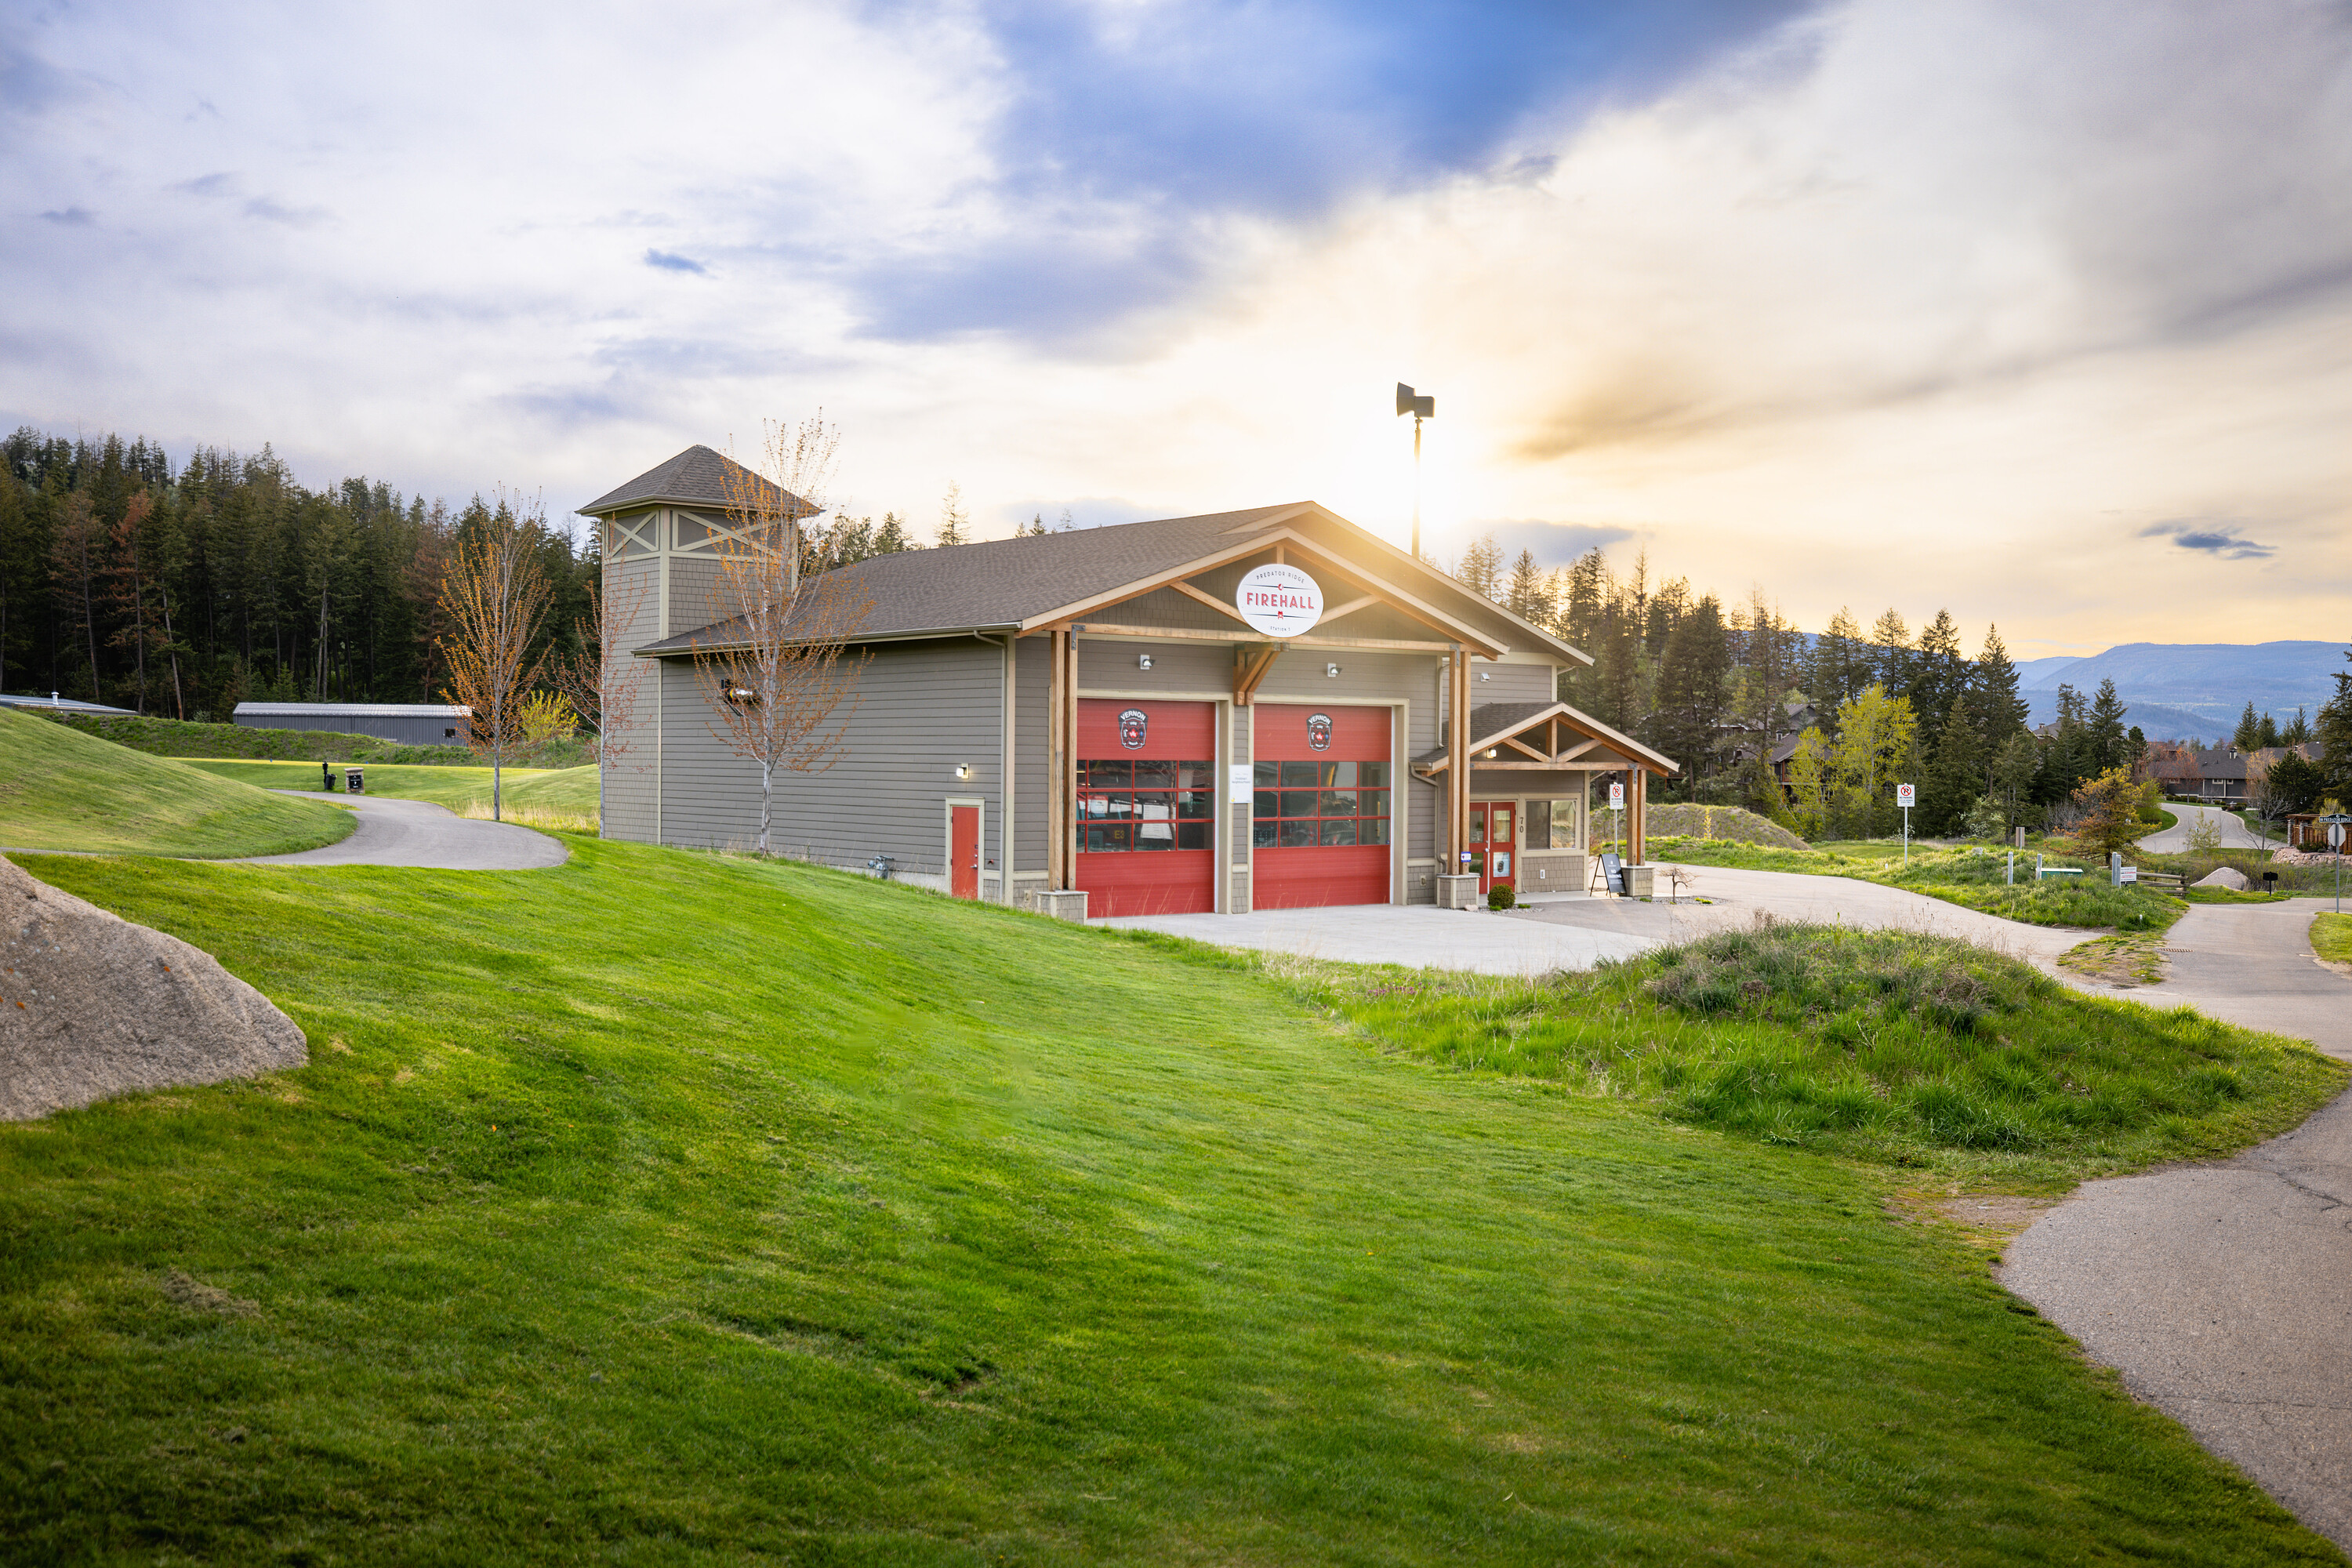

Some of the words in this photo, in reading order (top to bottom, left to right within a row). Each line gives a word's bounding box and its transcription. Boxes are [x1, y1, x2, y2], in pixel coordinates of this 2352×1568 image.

[1256, 571, 1286, 580] PREDATOR
[1288, 572, 1305, 583] RIDGE
[1247, 592, 1314, 609] FIREHALL
[1120, 710, 1146, 721] VERNON
[1308, 714, 1331, 724] VERNON
[1520, 817, 1524, 833] 70
[1114, 830, 1124, 839] E3
